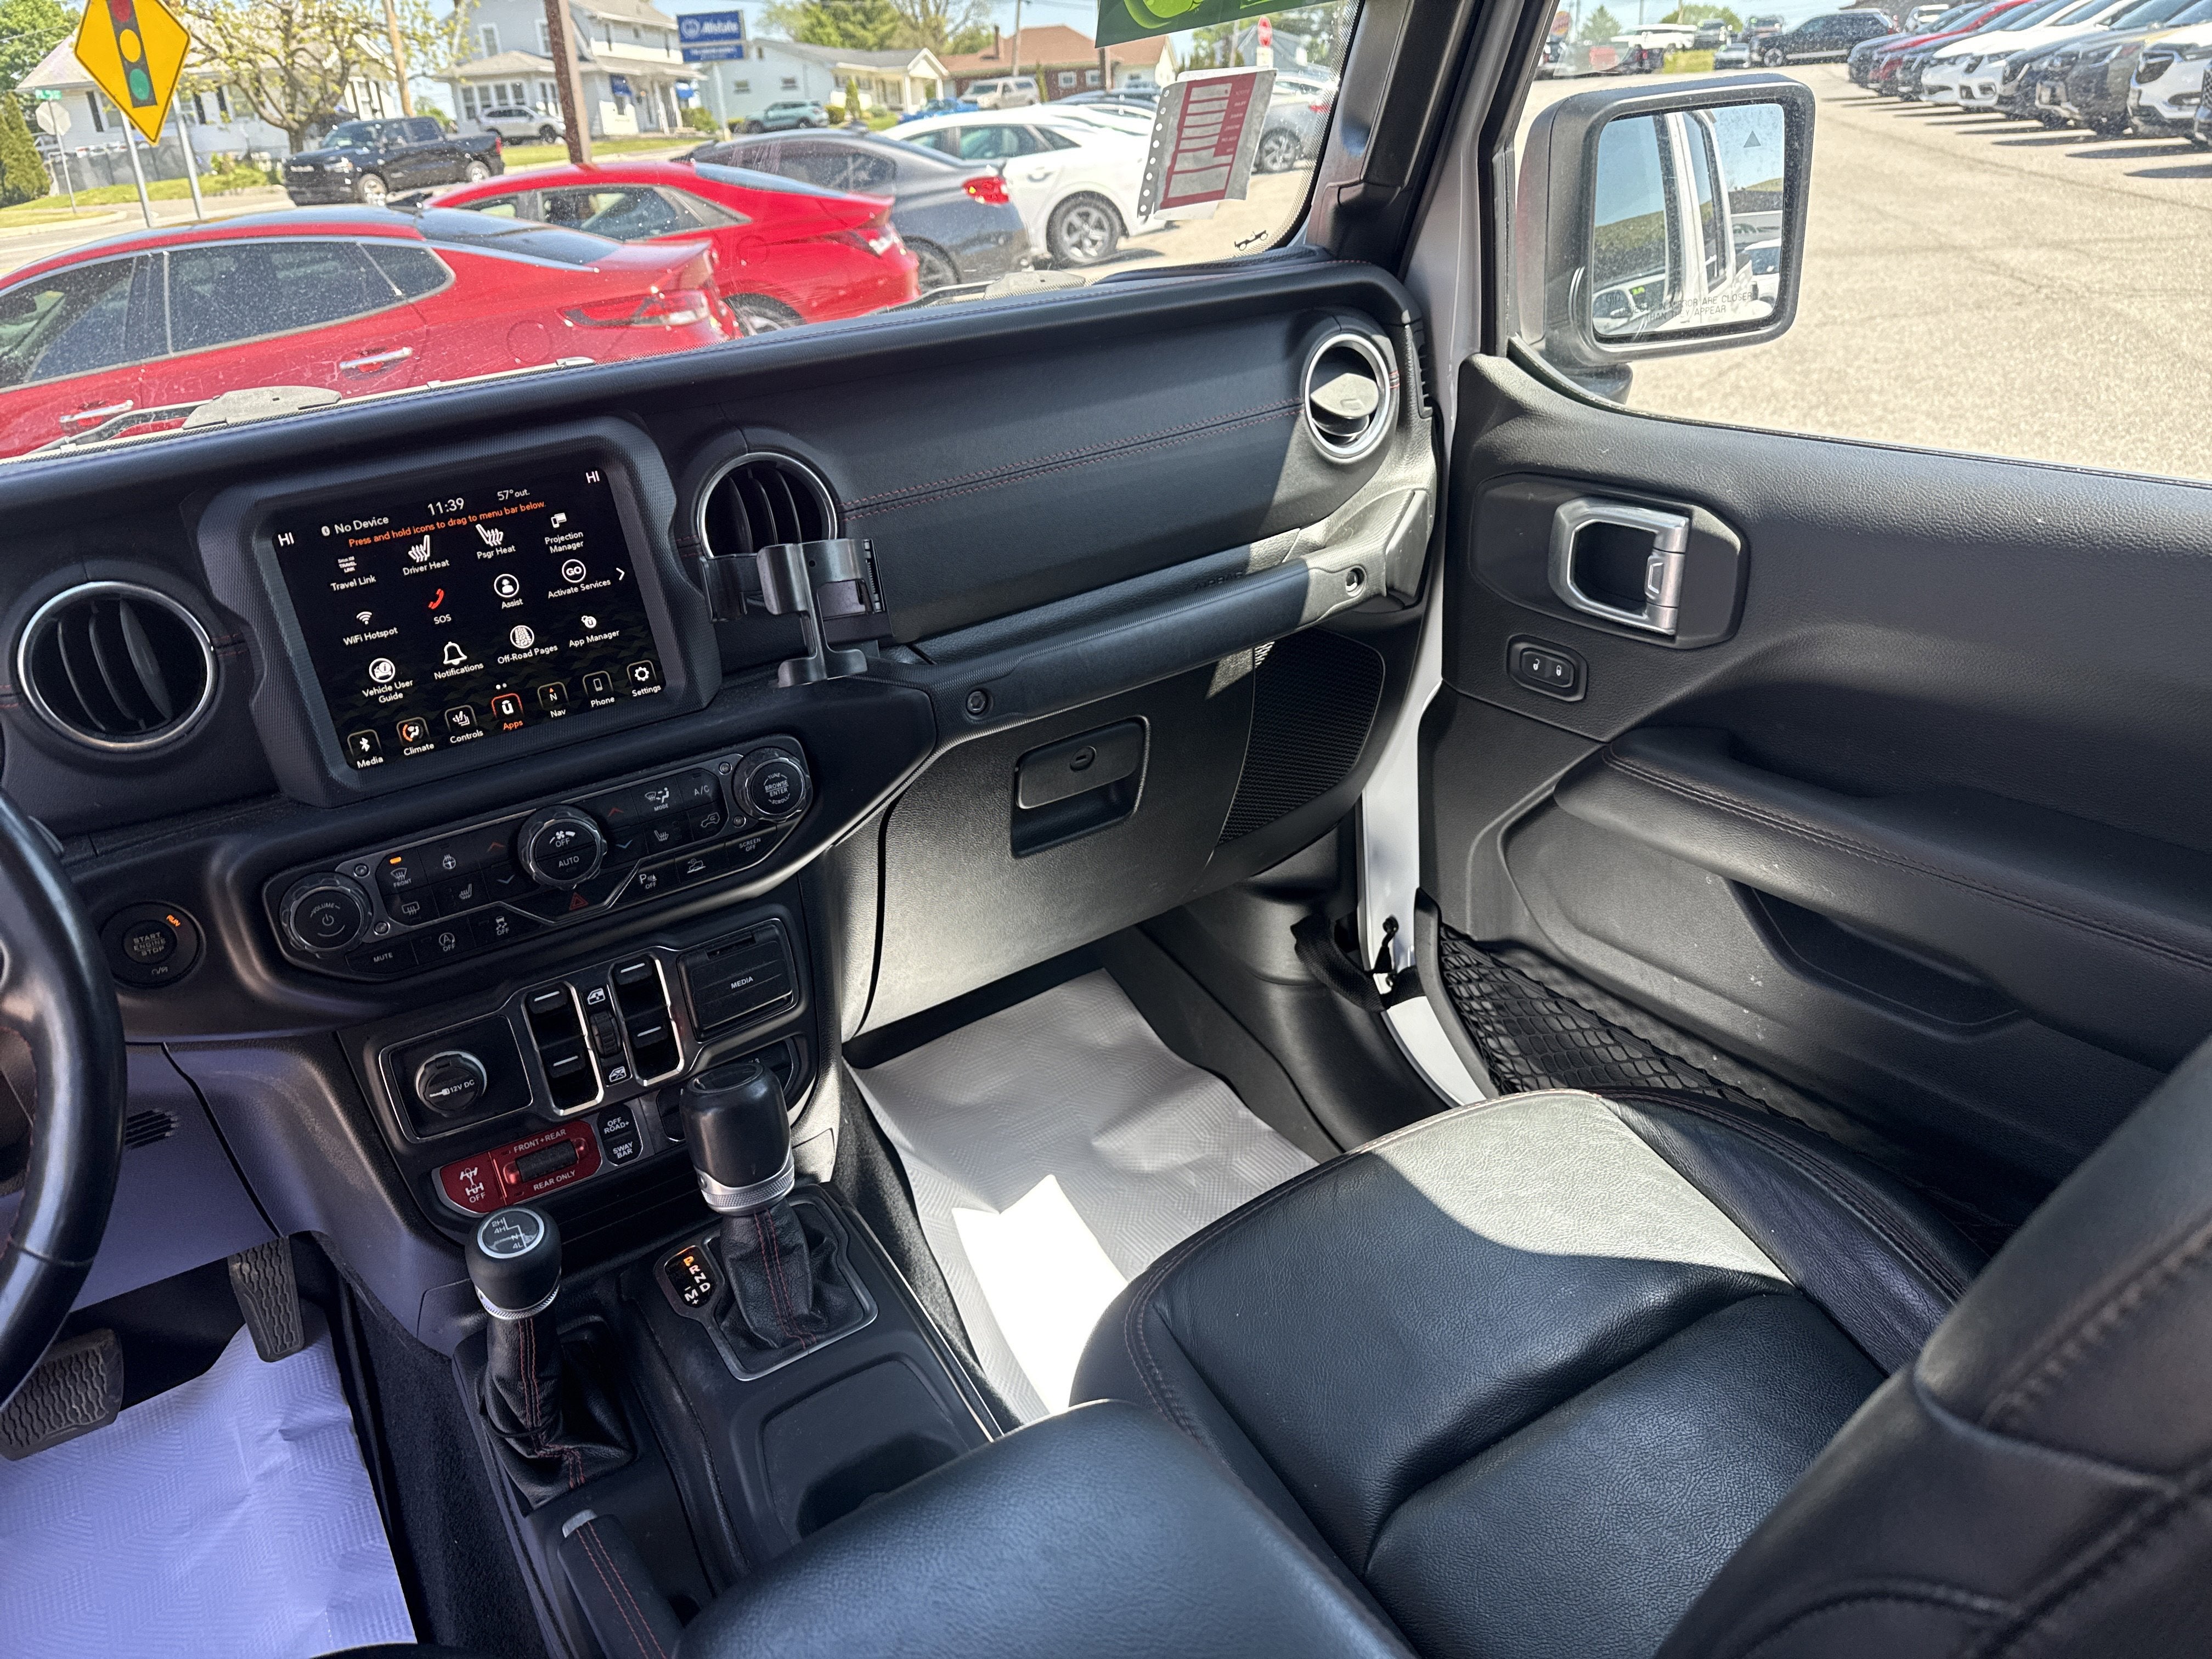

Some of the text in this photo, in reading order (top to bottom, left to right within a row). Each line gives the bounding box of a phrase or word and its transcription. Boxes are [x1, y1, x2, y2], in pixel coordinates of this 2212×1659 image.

[1702, 296, 1718, 305] ARE
[1722, 292, 1753, 303] CLOSER
[1646, 312, 1667, 321] THAN
[1694, 304, 1726, 316] APPEAR
[585, 470, 600, 483] HI
[427, 498, 464, 516] 11:39
[335, 516, 389, 534] No Device
[348, 538, 371, 548] Press
[374, 532, 390, 542] and
[392, 527, 411, 539] hold
[413, 523, 435, 534] icons
[436, 521, 445, 530] to
[448, 516, 467, 529] drag
[469, 513, 477, 522] to
[479, 510, 503, 521] menu
[504, 504, 518, 515] bar
[278, 532, 295, 547] HI
[544, 531, 584, 545] Projection
[477, 544, 516, 560] Psgr Heat
[550, 540, 584, 554] Manager
[403, 559, 450, 575] Driver Heat
[566, 566, 582, 577] GO
[330, 574, 376, 591] Travel Link
[548, 579, 611, 599] Activate Services
[501, 599, 523, 610] Assist
[433, 614, 452, 624] SOS
[343, 627, 398, 646] WiFi Hotspot
[569, 630, 620, 648] App Manager
[498, 645, 558, 664] Off-Road Pages
[433, 663, 484, 679] Notifications
[362, 679, 414, 697] Vehicle User
[631, 685, 661, 697] Settings
[379, 692, 404, 703] Guide
[590, 696, 615, 708] Phone
[550, 708, 566, 718] Nav
[503, 719, 523, 731] Apps
[450, 730, 484, 744] Controls
[403, 742, 435, 756] Climate
[357, 755, 383, 769] Media
[694, 785, 710, 797] A/C
[765, 780, 789, 791] BROWSE
[770, 787, 788, 797] ENTER
[771, 796, 789, 805] SCROLL
[653, 803, 669, 812] MODE
[555, 837, 572, 848] OFF
[739, 837, 761, 850] SCREEN
[745, 844, 757, 853] OFF
[558, 856, 579, 868] AUTO
[393, 878, 412, 888] FRONT
[645, 881, 657, 889] OFF
[312, 902, 335, 915] VOLUME
[166, 914, 180, 927] RUN
[133, 932, 161, 943] START
[496, 928, 510, 936] OFF
[134, 938, 166, 951] ENGINE
[141, 946, 165, 956] STOP
[373, 952, 393, 963] MUTE
[731, 976, 754, 989] MEDIA
[450, 1079, 475, 1093] 12V DC
[604, 1120, 630, 1135] ROAD+
[607, 1117, 622, 1127] OFF
[613, 1141, 633, 1155] SWAY
[617, 1148, 633, 1159] BAR
[533, 1170, 576, 1191] REAR ONLY
[469, 1192, 486, 1204] OFF
[492, 1218, 504, 1228] 2H
[494, 1226, 506, 1234] 4H
[512, 1242, 523, 1250] 4L
[684, 1256, 694, 1266] P
[689, 1265, 701, 1274] R
[694, 1272, 706, 1283] N
[699, 1282, 710, 1293] D
[685, 1289, 698, 1301] M
